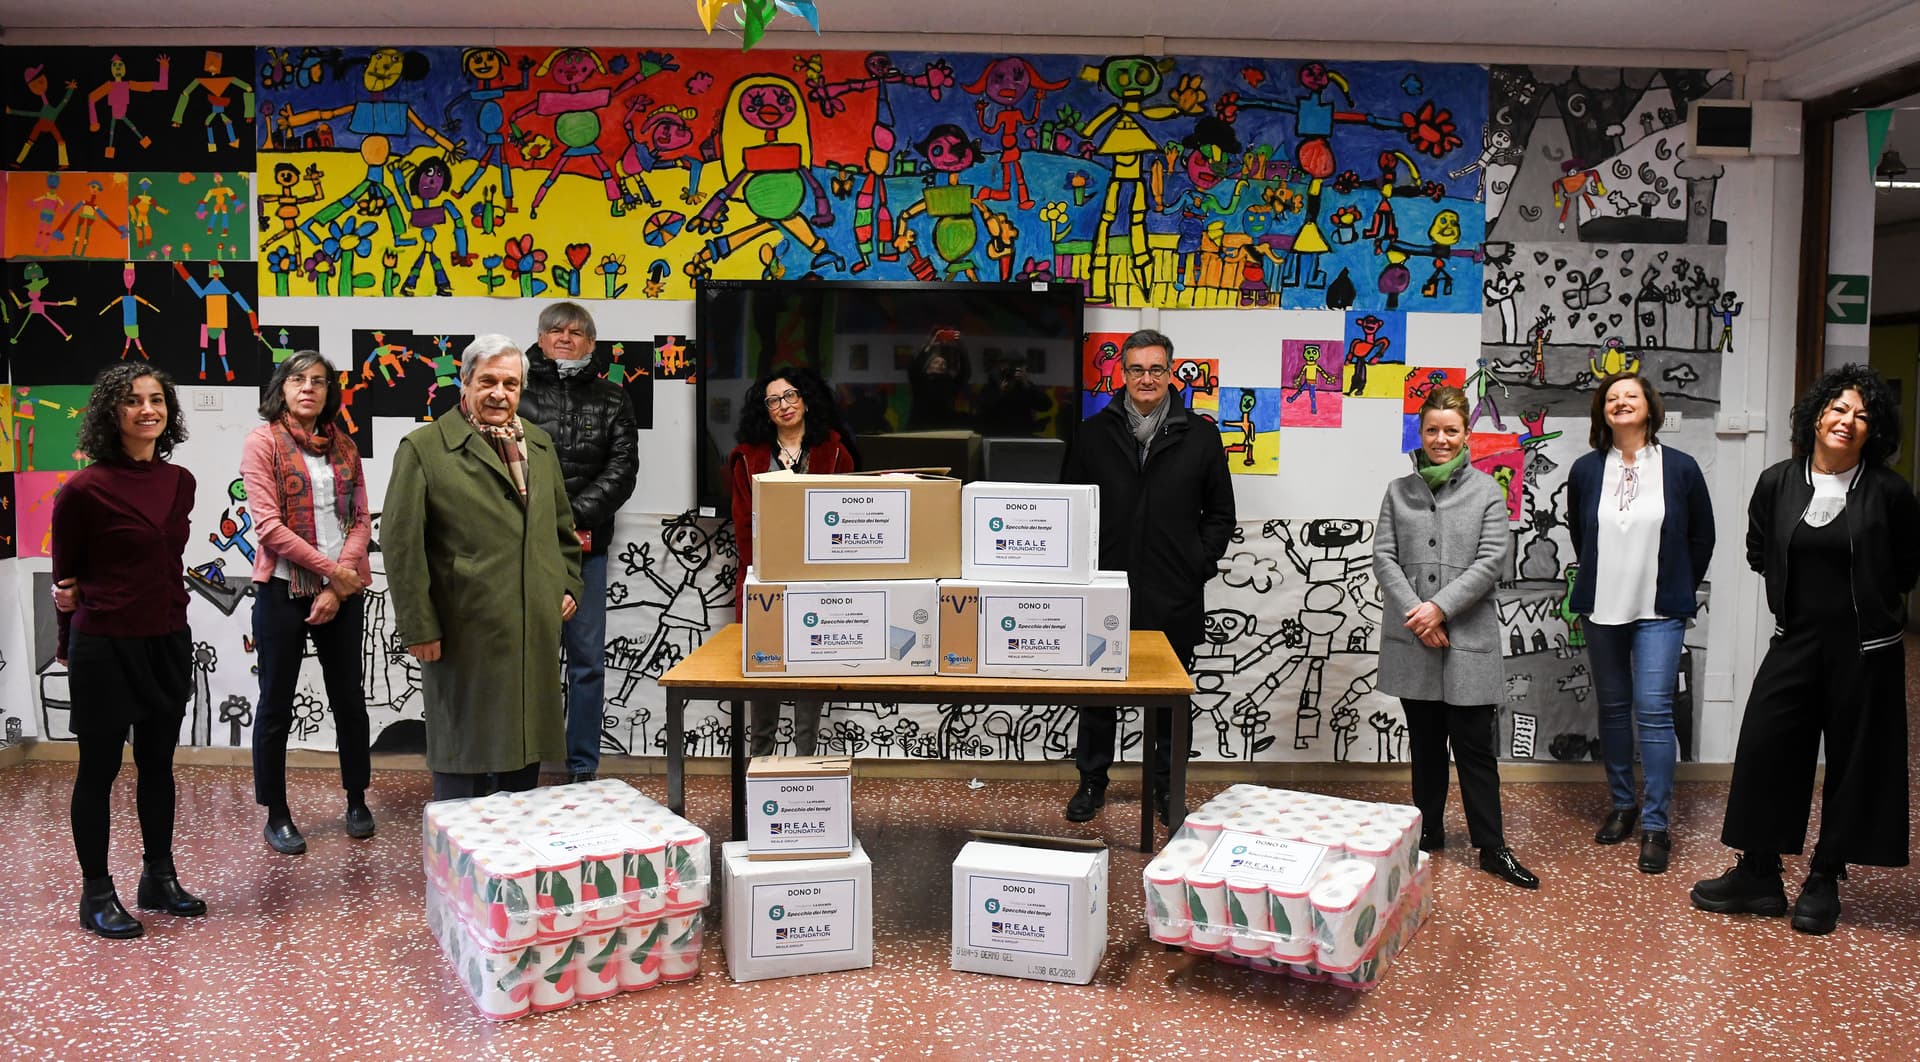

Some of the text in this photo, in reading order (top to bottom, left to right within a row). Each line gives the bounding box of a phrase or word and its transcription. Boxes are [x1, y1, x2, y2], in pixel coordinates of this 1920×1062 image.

[1003, 885, 1025, 893] DONO
[790, 925, 830, 933] REALE
[1005, 923, 1045, 932] REALE
[1005, 930, 1045, 938] FOUNDATION
[980, 950, 999, 960] DERMO
[1002, 952, 1014, 962] GEL
